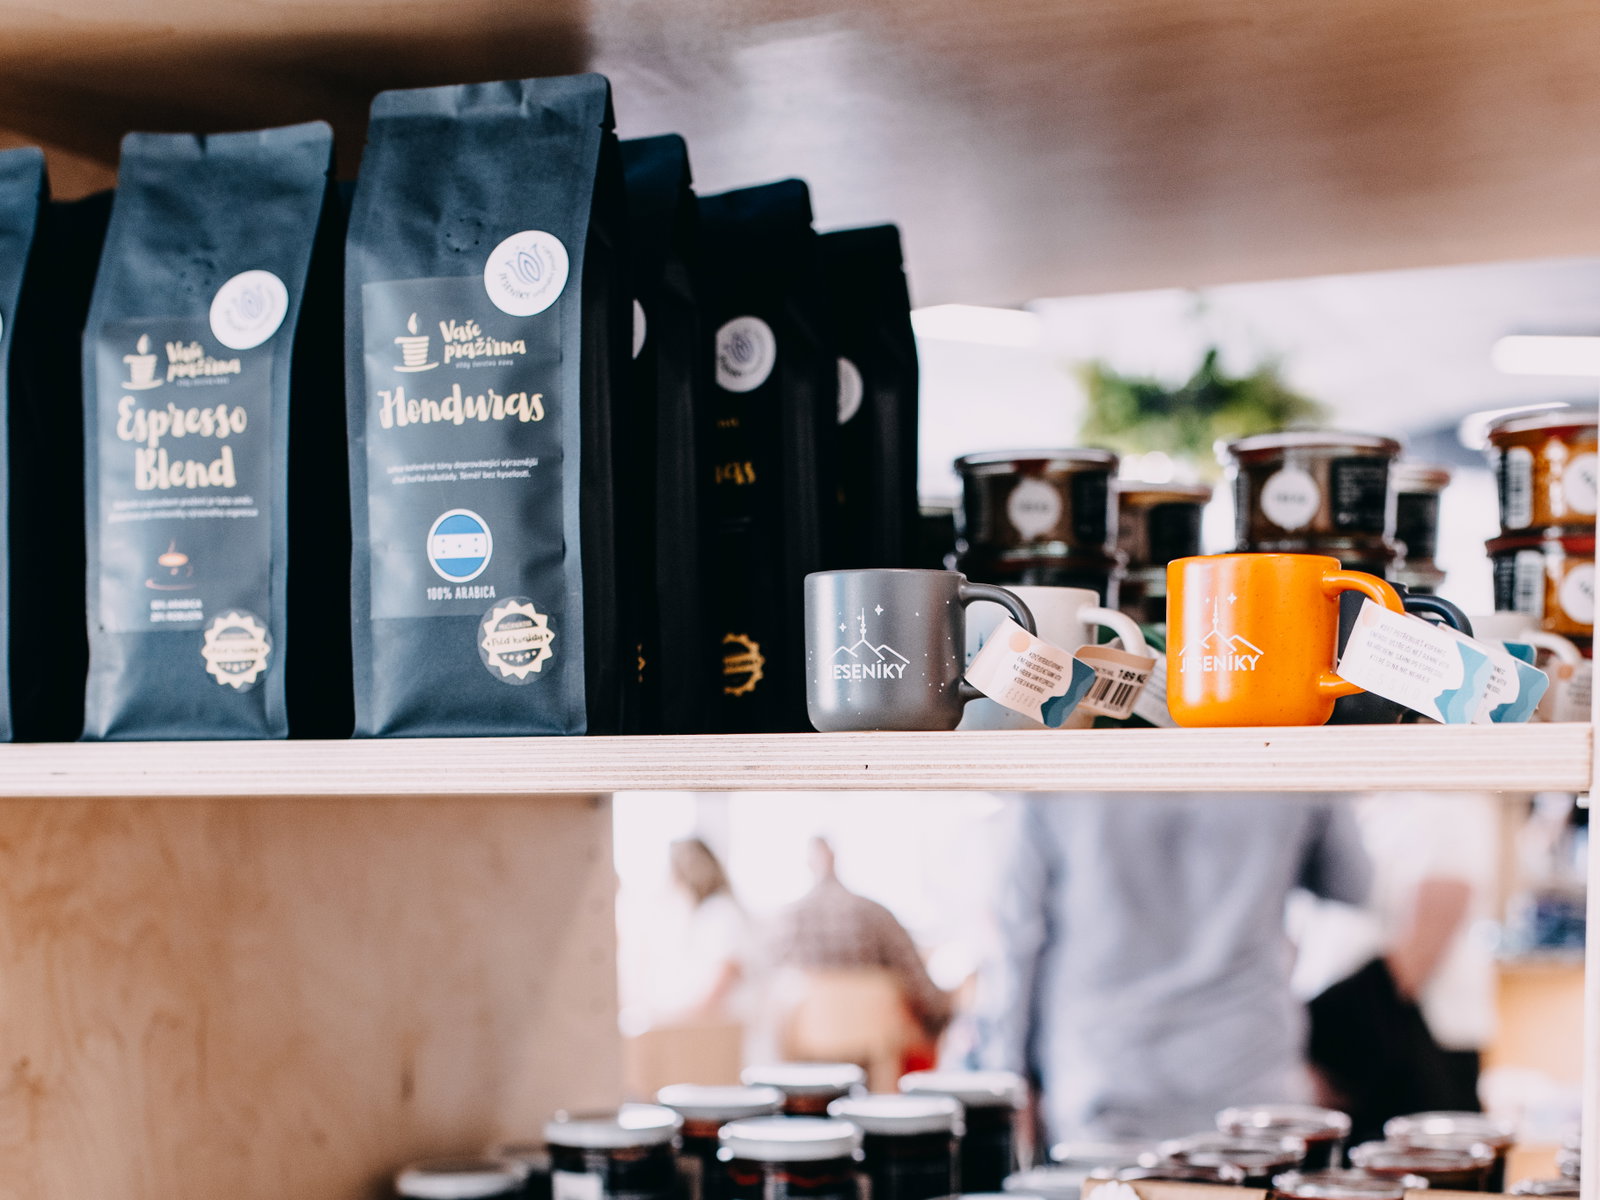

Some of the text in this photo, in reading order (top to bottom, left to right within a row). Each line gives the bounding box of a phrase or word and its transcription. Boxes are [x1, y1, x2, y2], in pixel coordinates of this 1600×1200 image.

[439, 319, 481, 342] Vaše
[444, 336, 527, 364] pražírna
[377, 383, 545, 429] Honduras
[116, 395, 248, 449] Espresso
[135, 445, 237, 490] Blend
[426, 585, 496, 600] 100% ARABICA
[828, 659, 907, 680] ESENÍKY
